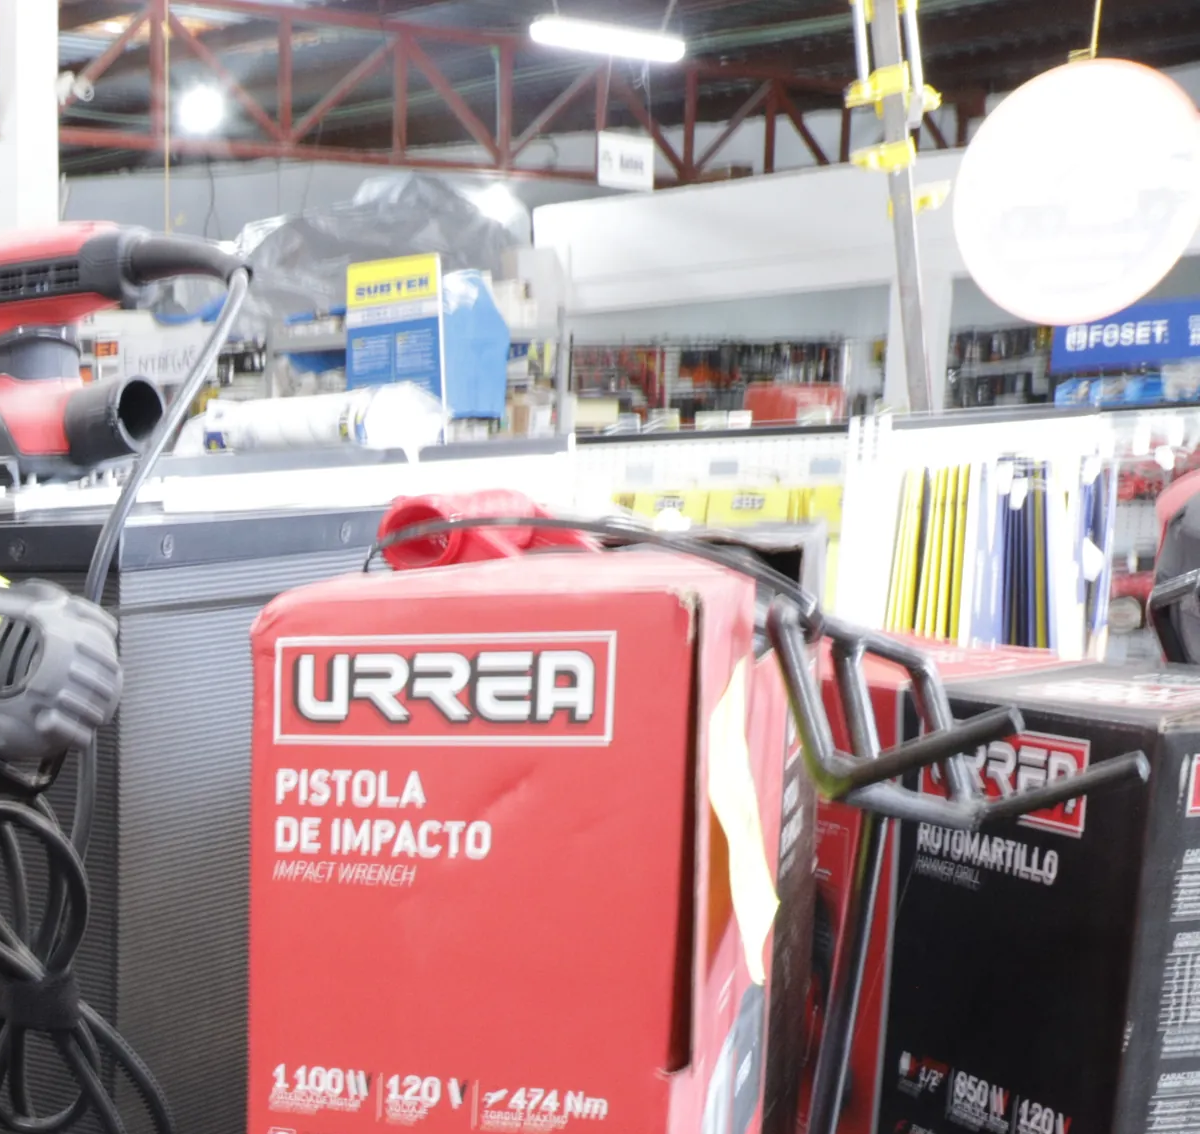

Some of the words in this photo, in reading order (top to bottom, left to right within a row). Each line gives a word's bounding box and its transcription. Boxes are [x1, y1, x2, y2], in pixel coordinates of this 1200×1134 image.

[293, 650, 596, 723] URREA
[275, 768, 427, 809] PISTOLA
[273, 816, 322, 854] DE
[330, 818, 493, 861] IMPACTO
[916, 820, 1060, 886] ROTOMARTILLO
[272, 858, 334, 884] IMPACT
[337, 861, 417, 888] WRENCH
[914, 853, 953, 880] HAMMER
[954, 864, 982, 892] DRILL
[385, 1074, 442, 1108] 120
[507, 1087, 561, 1112] 474
[563, 1089, 609, 1121] Nm
